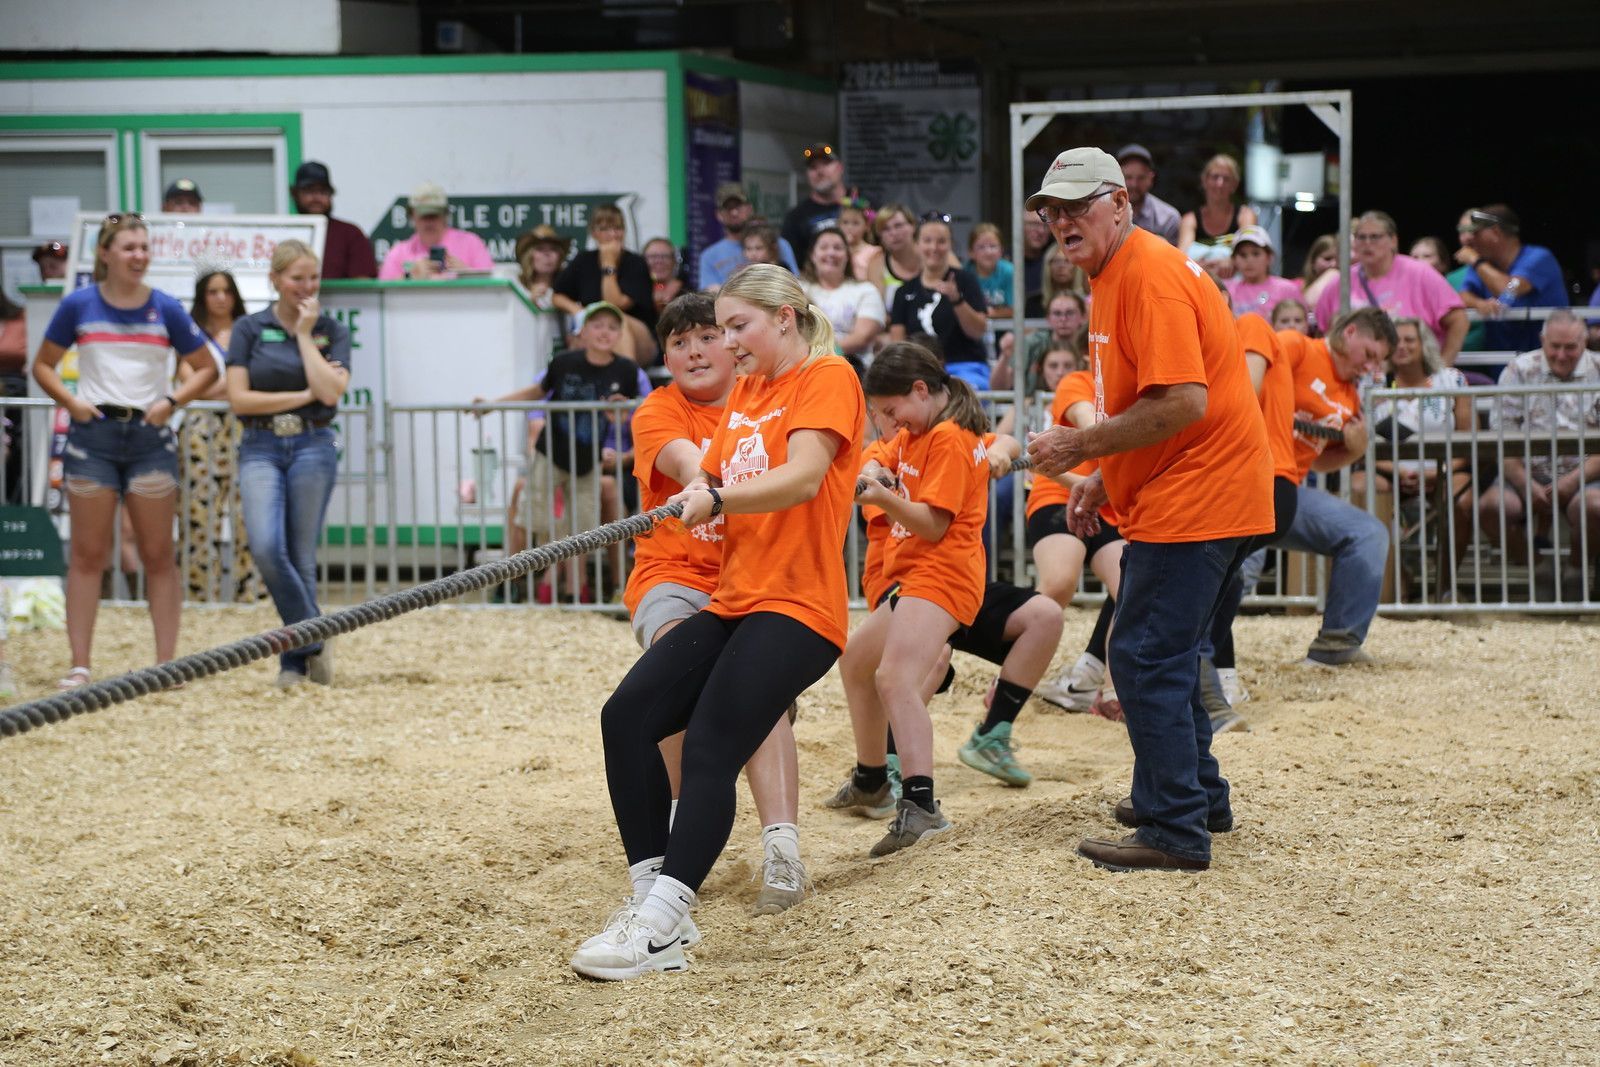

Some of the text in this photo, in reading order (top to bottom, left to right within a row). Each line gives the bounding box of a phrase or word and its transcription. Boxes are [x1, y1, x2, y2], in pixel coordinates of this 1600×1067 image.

[391, 202, 588, 229] BTLE OF THE
[151, 231, 184, 258] ttle
[188, 231, 212, 257] of
[215, 232, 247, 258] the
